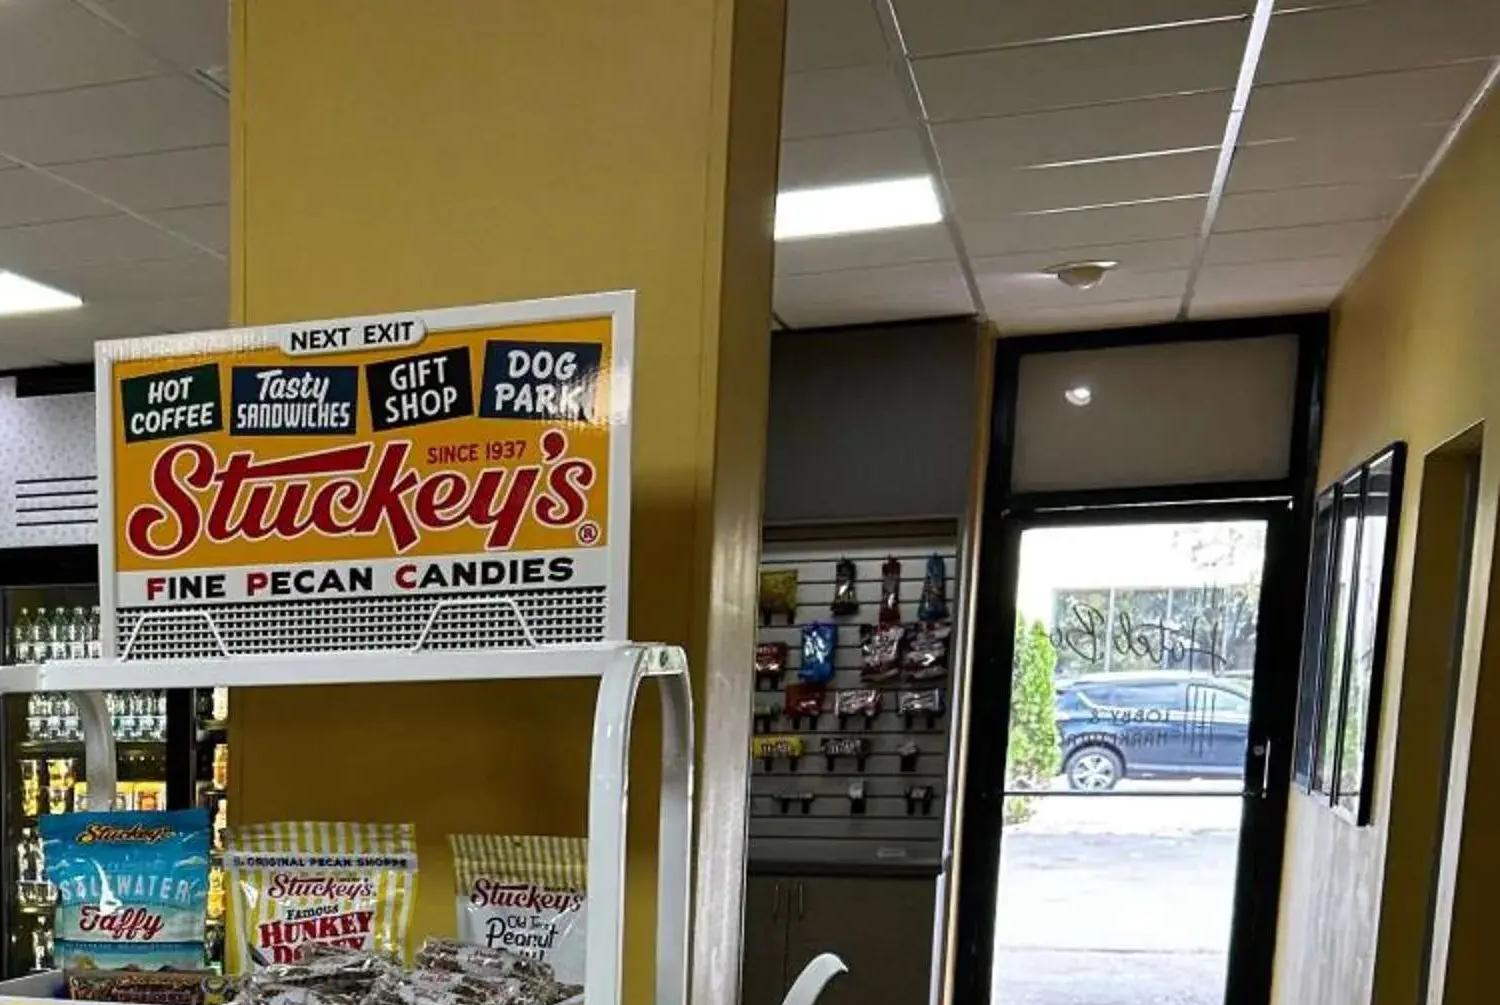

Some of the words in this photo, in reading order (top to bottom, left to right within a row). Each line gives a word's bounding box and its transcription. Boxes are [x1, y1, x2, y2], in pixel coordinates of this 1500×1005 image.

[291, 328, 350, 350] NEXT
[363, 321, 414, 344] EXIT
[389, 356, 449, 391] GIFT
[507, 350, 577, 380] DOG
[147, 376, 194, 404] HOT
[256, 369, 331, 401] Tasty
[494, 382, 582, 415] PARK
[130, 402, 215, 435] COFFEE
[236, 401, 351, 429] SANDWICHES
[385, 386, 458, 423] SHOP
[427, 444, 478, 464] SINCE
[485, 440, 527, 461] 1937
[127, 430, 596, 557] Stuckey's
[146, 574, 227, 601] FINE
[245, 567, 373, 595] PECAN
[394, 557, 574, 590] CANDIES
[59, 872, 191, 905] SALWATER
[268, 874, 373, 900] Stuckey's
[258, 911, 374, 948] HUNKEY
